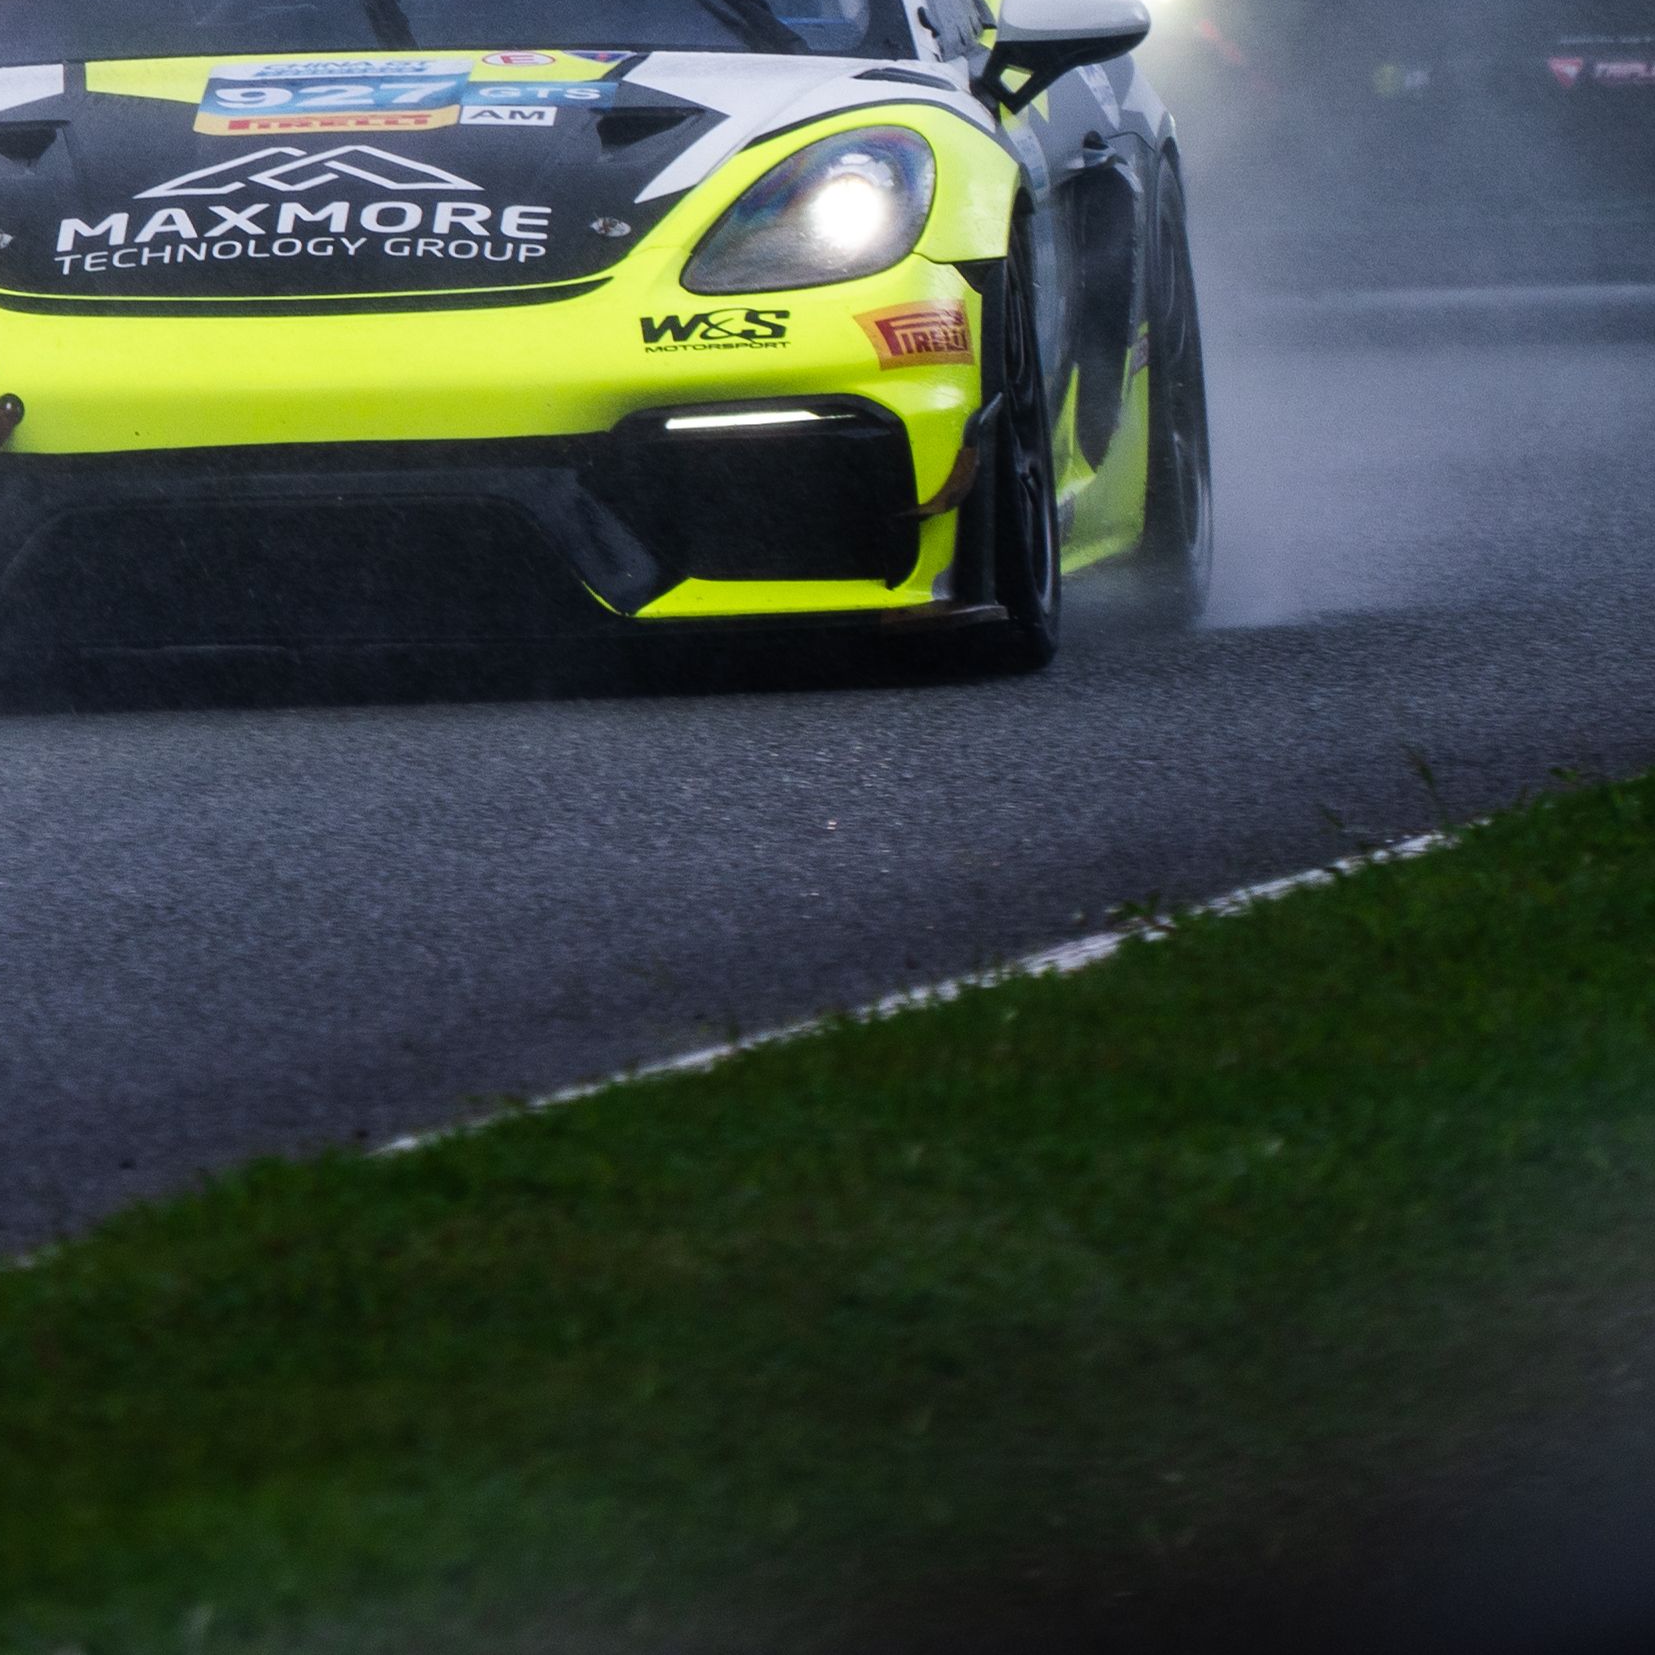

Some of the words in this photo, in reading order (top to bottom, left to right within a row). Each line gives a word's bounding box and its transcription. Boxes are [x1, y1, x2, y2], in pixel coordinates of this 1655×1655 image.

[214, 80, 457, 109] 927
[227, 113, 433, 131] PIRELLI
[467, 108, 546, 122] AM
[55, 201, 552, 252] MAXMORE
[54, 236, 367, 275] TECHNOLOGY
[384, 237, 546, 263] GROUP
[640, 307, 791, 343] W&S
[644, 341, 791, 353] MOTORSPORT
